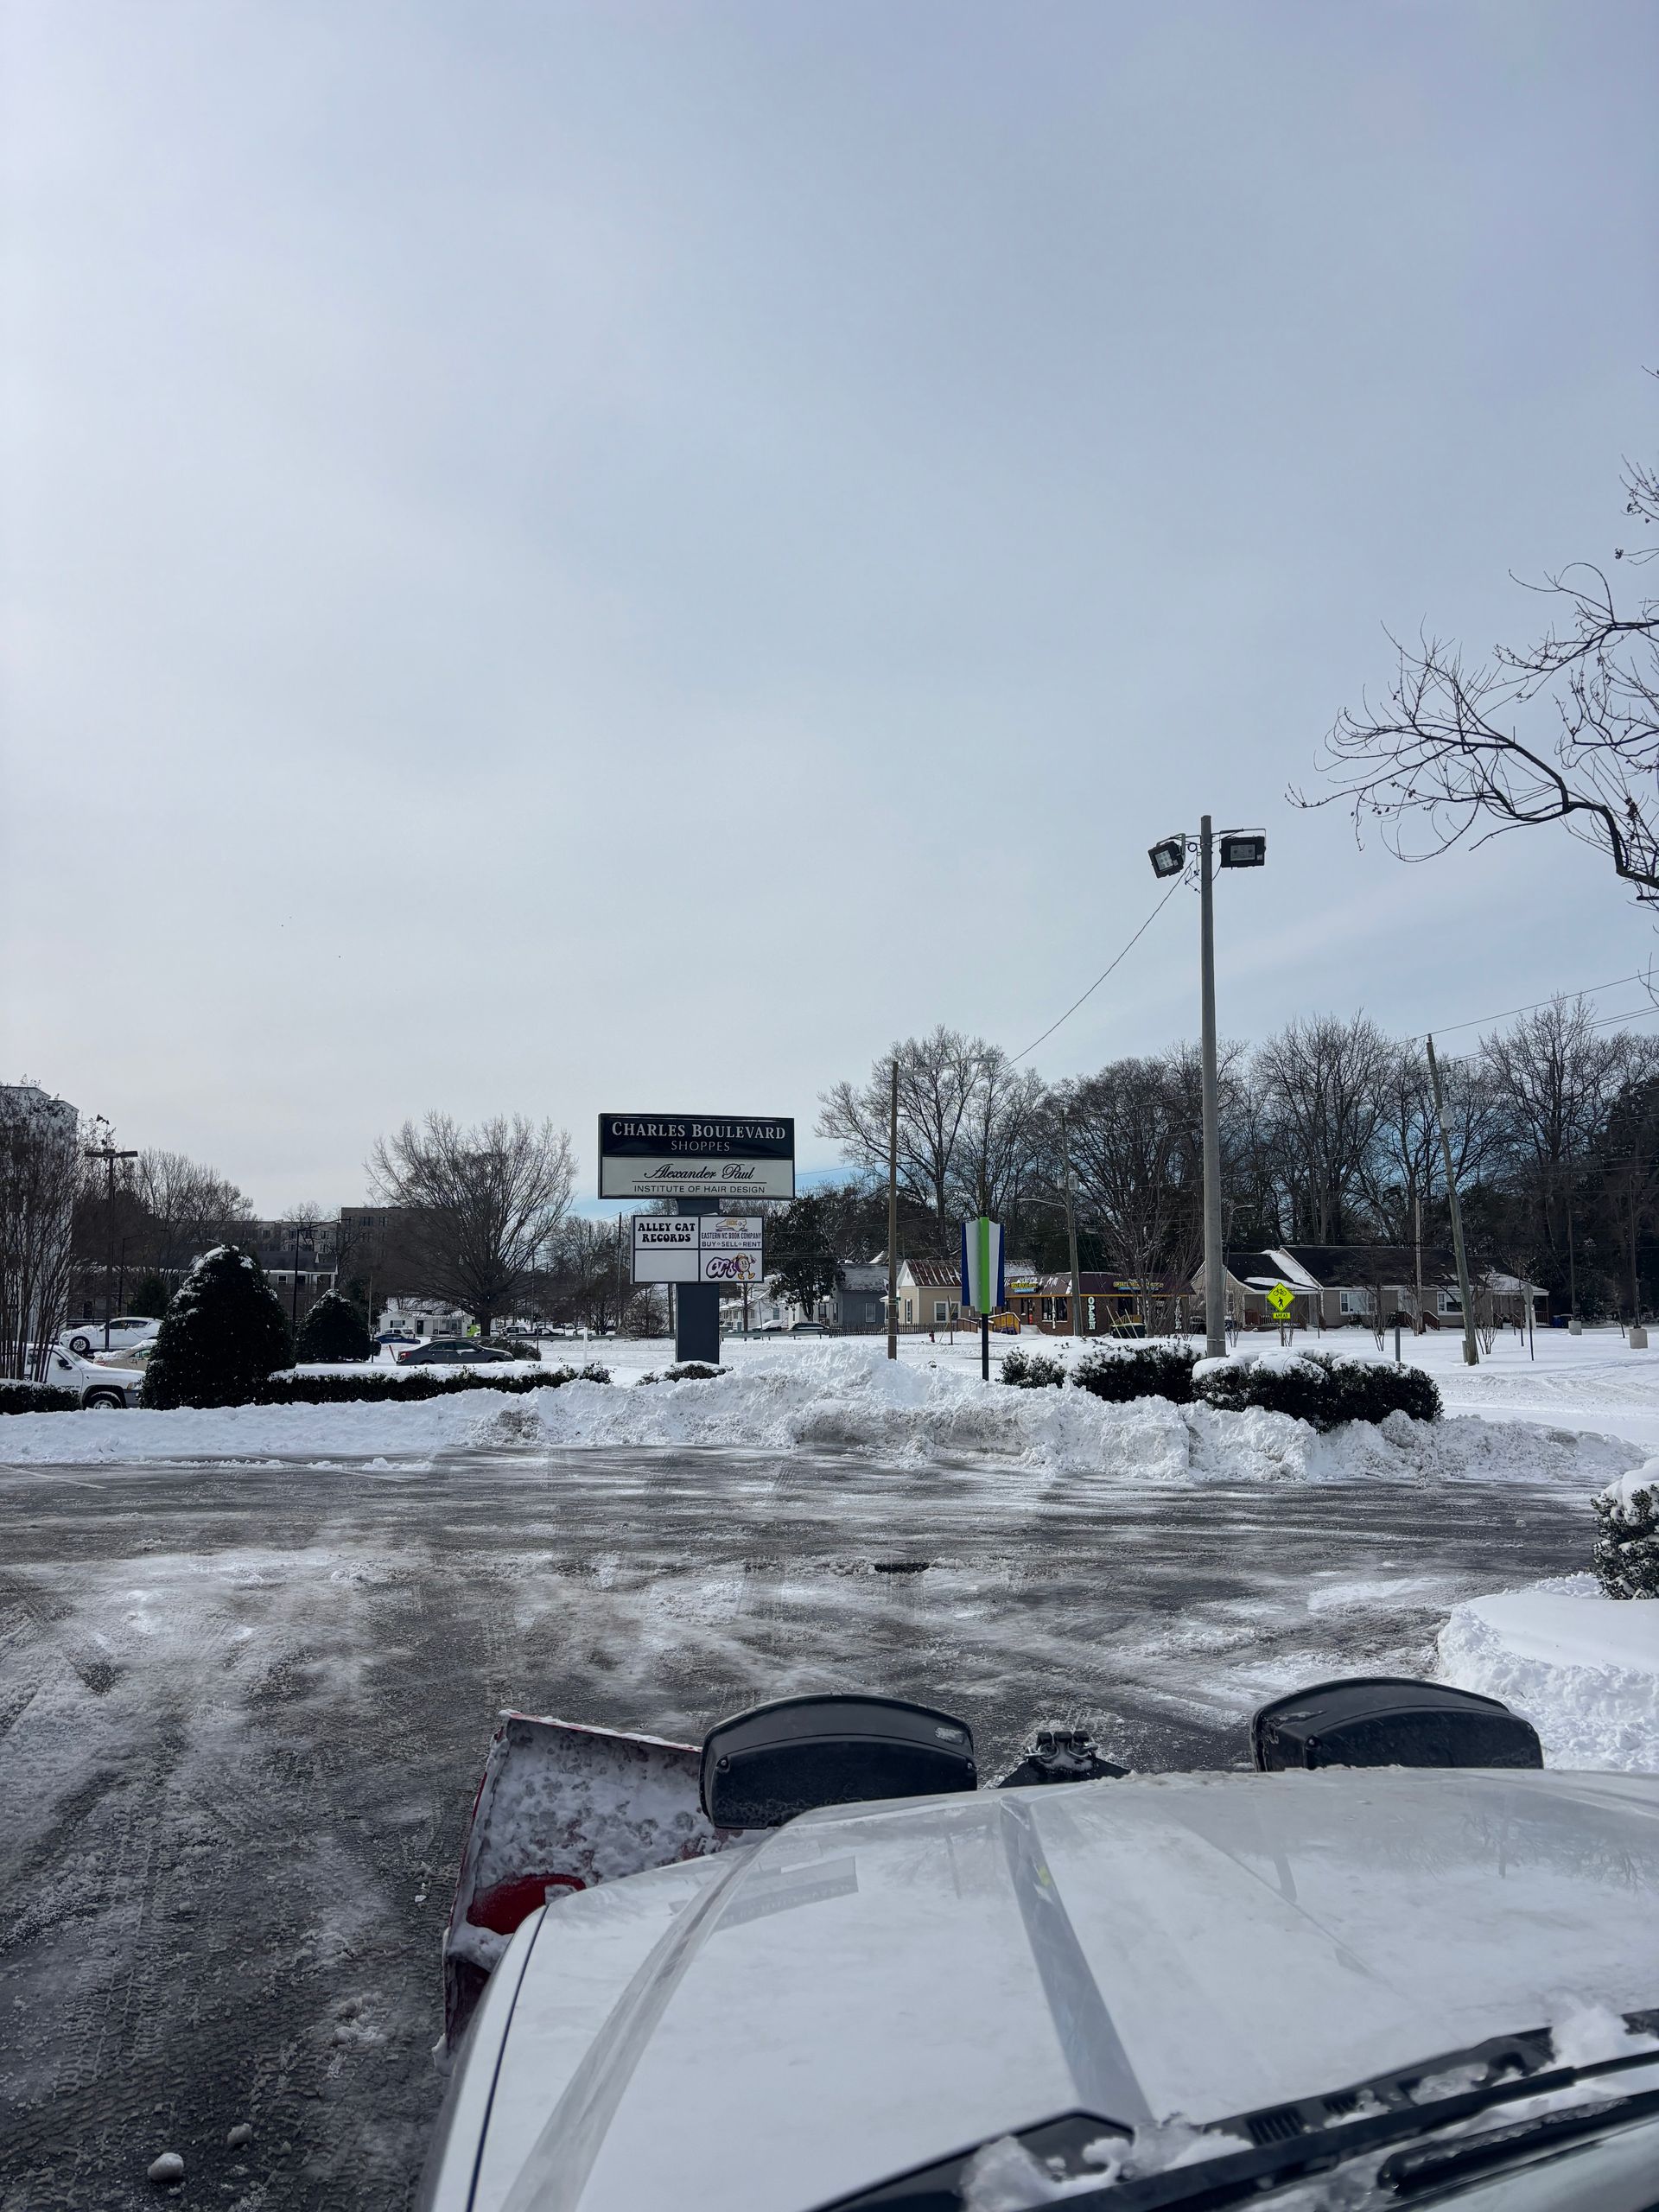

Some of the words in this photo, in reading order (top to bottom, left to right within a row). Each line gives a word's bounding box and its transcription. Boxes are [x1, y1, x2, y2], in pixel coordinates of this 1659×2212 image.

[612, 1122, 685, 1137] CHARLES
[691, 1124, 786, 1139] BOULEVARD
[671, 1141, 730, 1152] SHOPPES
[644, 1163, 716, 1179] Alexander
[721, 1163, 755, 1179] Paul
[634, 1185, 684, 1193] INSTITUTE
[638, 1223, 671, 1231] ALLEY
[675, 1223, 696, 1231] CAT
[642, 1234, 691, 1243] RECORDS
